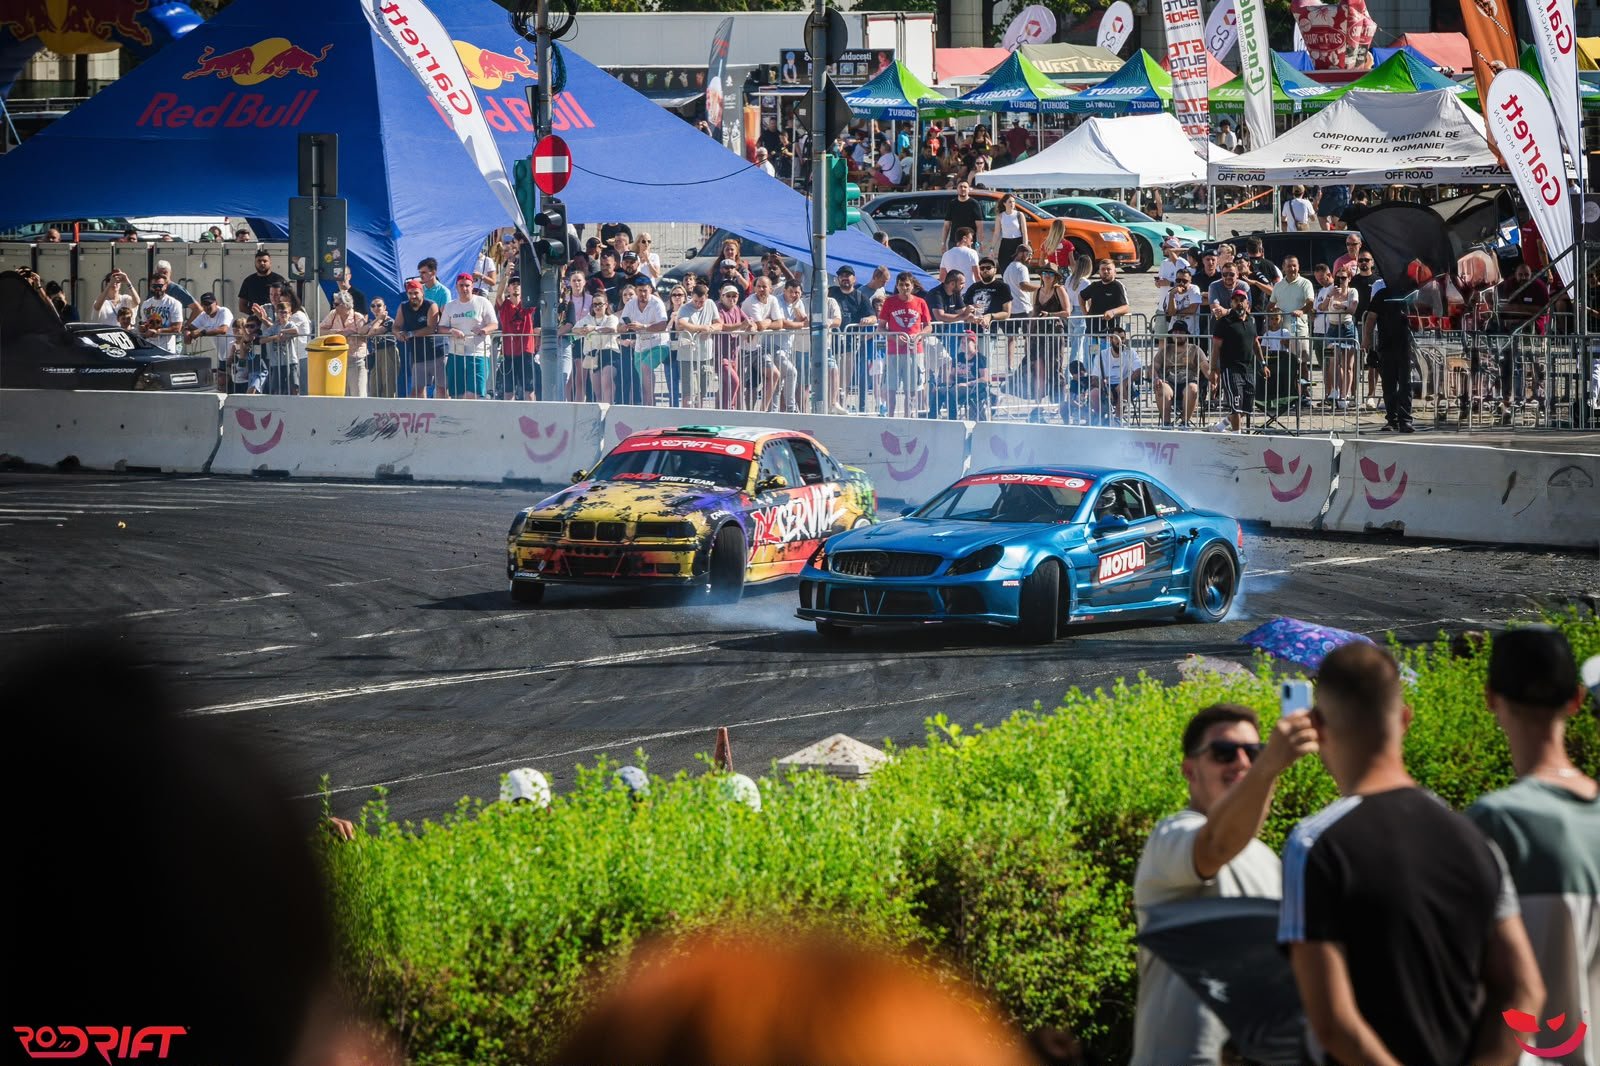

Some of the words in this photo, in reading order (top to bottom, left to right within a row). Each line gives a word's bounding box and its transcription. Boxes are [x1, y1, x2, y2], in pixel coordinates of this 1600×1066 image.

[967, 87, 1024, 101] TUBORG
[1087, 86, 1148, 96] TUBORG
[846, 96, 902, 106] TUBORG
[1009, 100, 1038, 110] TUBORG
[1042, 101, 1070, 110] TUBORG
[1131, 101, 1160, 109] TUBORG
[135, 91, 237, 128] Red
[224, 89, 320, 128] Bull
[887, 107, 916, 118] TUBORG
[1313, 131, 1389, 144] CAMPIONATUL
[1391, 130, 1442, 143] NATIONAL
[1444, 130, 1460, 138] DE
[1321, 143, 1342, 151] OFF
[1343, 145, 1374, 154] ROAD
[1392, 142, 1445, 152] ROMANIEI
[1217, 173, 1236, 181] OFF
[1237, 173, 1266, 181] ROAD
[1385, 170, 1404, 180] OFF
[1405, 170, 1433, 180] ROAD
[659, 475, 688, 483] DRIFT
[688, 477, 716, 487] TEAM
[777, 482, 848, 542] SERVICE
[1100, 548, 1145, 579] MOTUL
